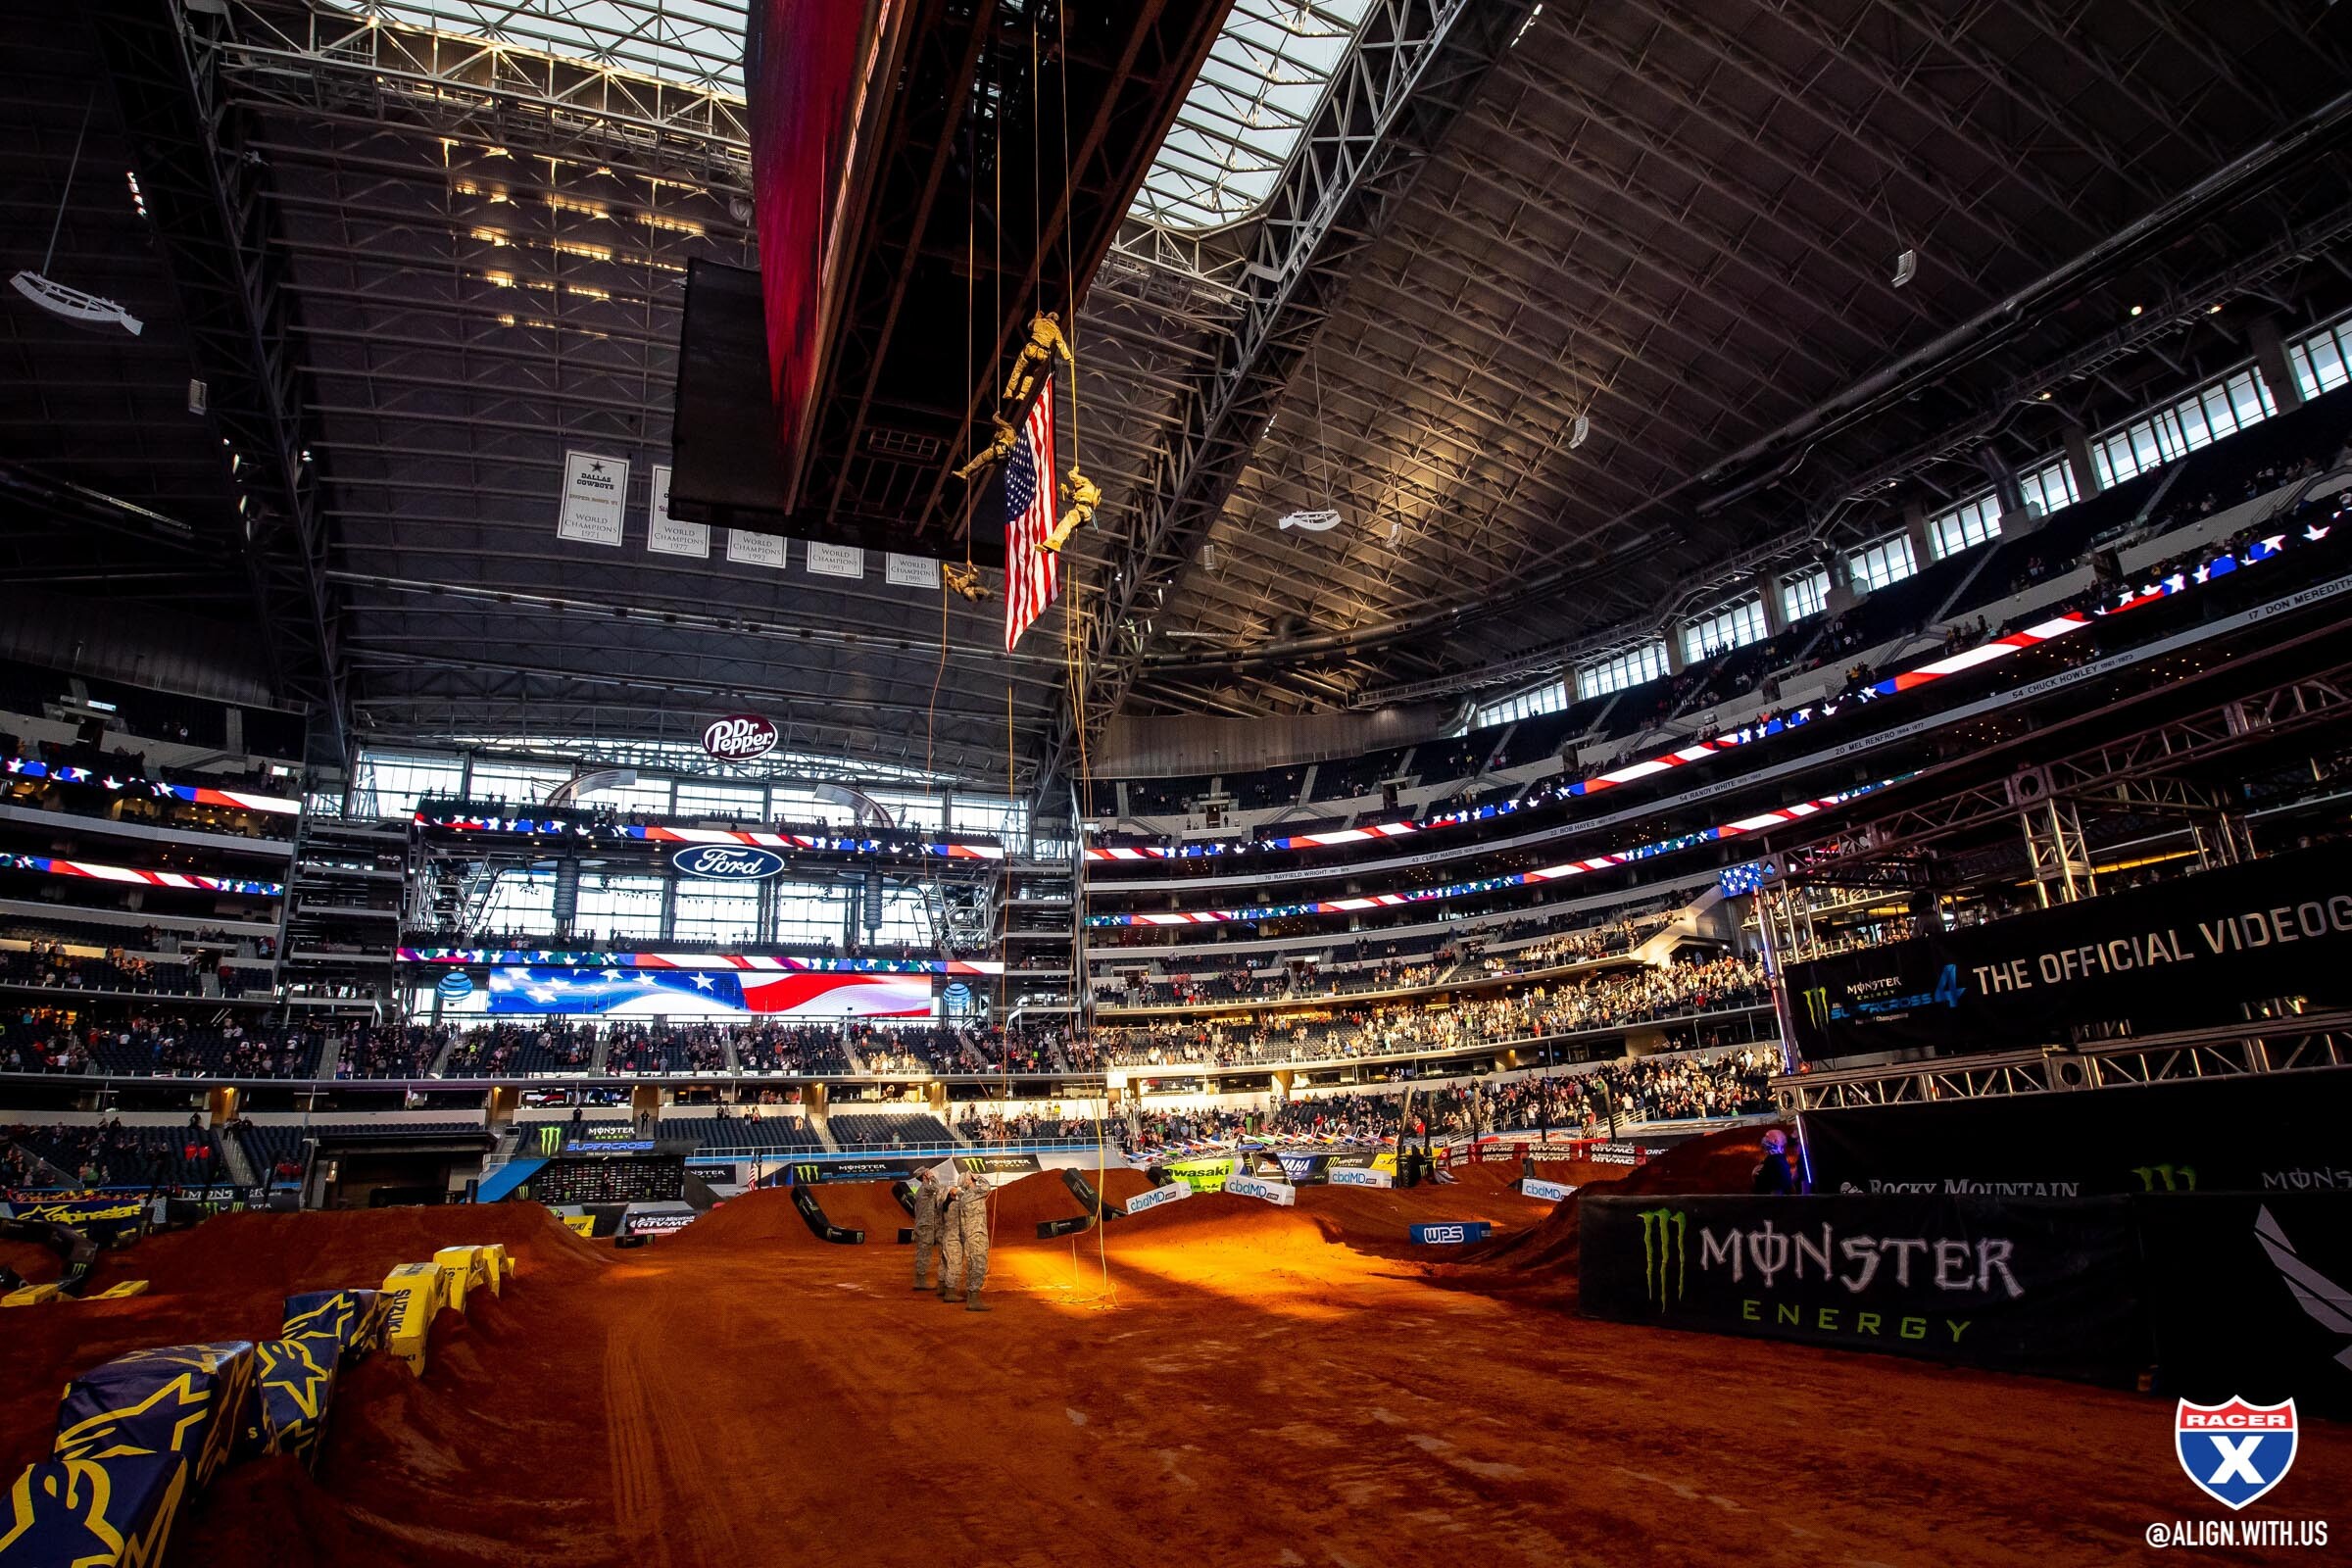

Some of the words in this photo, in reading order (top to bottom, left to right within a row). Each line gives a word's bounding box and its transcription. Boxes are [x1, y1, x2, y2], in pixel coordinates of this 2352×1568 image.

[576, 479, 614, 490] COWBOYS
[581, 472, 612, 483] DALLAS
[564, 519, 617, 533] CHAMPIONS
[575, 513, 608, 524] WORLD
[654, 532, 705, 545] CHAMPIONS
[664, 525, 696, 537] WORLD
[733, 543, 782, 556] CHAMPIONS
[743, 536, 773, 547] WORLD
[812, 555, 858, 566] CHAMPIONS
[821, 548, 851, 558] WORLD
[891, 565, 935, 577] CHAMPIONS
[899, 560, 927, 569] WORLD
[2248, 610, 2259, 619] 17
[2265, 599, 2290, 614] DON
[2012, 690, 2024, 699] 54
[2028, 679, 2057, 694] CHUCK
[2059, 664, 2098, 683] HOWLEY
[732, 718, 759, 738] Dr
[1848, 741, 1864, 751] MEL
[1865, 731, 1895, 746] RENFRO
[1690, 788, 1712, 799] RANDY
[1713, 781, 1735, 792] WHITE
[1574, 821, 1595, 830] HAYES
[694, 849, 764, 875] Ford
[1972, 957, 2033, 996] THE
[2038, 929, 2196, 985] OFFICIAL
[1846, 976, 1902, 996] MONSTER
[1934, 963, 1968, 1009] 4
[588, 1126, 635, 1135] MONSTER
[565, 1141, 657, 1152] SUPERCROSS
[1332, 1171, 1366, 1184] cbdMD
[1229, 1179, 1267, 1198] cbdMD
[1526, 1183, 1561, 1200] cbdMD
[1942, 1176, 2079, 1197] MOUNTAIN
[1130, 1191, 1165, 1211] cbdMD
[49, 1204, 141, 1225] alpinestars
[1423, 1225, 1464, 1244] WPS
[1698, 1218, 2026, 1298] MONSTER
[1742, 1298, 1973, 1344] ENERGY
